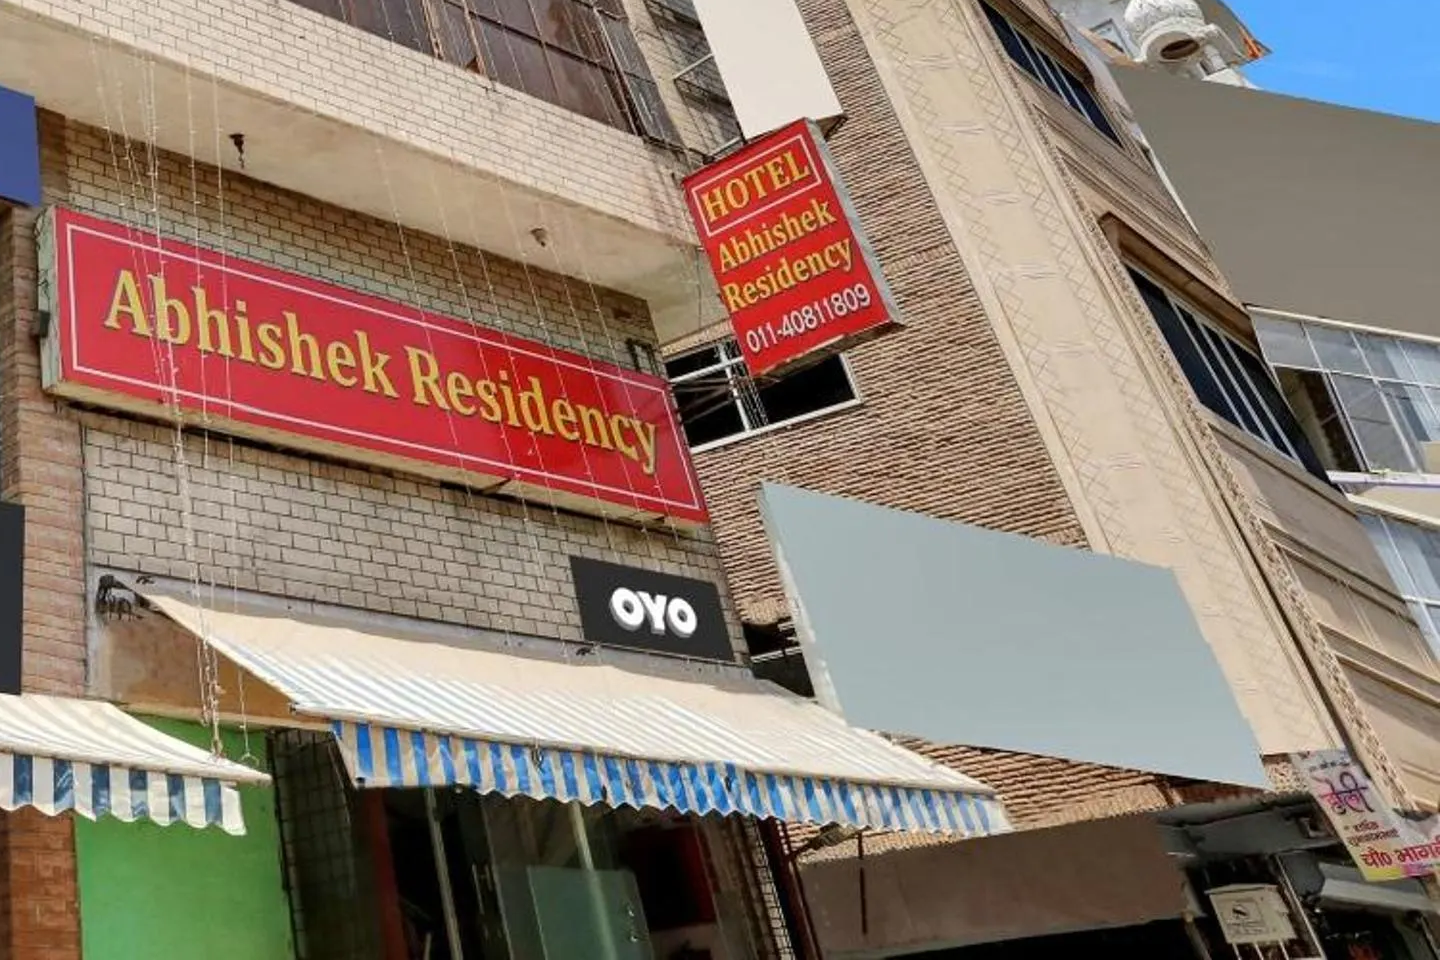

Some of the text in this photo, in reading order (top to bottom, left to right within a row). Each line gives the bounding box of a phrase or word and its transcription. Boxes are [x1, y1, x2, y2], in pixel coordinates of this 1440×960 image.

[701, 151, 810, 223] HOTEL
[718, 198, 837, 273] Abhishek
[721, 238, 855, 313] Residency
[745, 283, 872, 353] 011-40811809
[103, 267, 658, 474] Abhishek Residency
[610, 587, 698, 638] OYO
